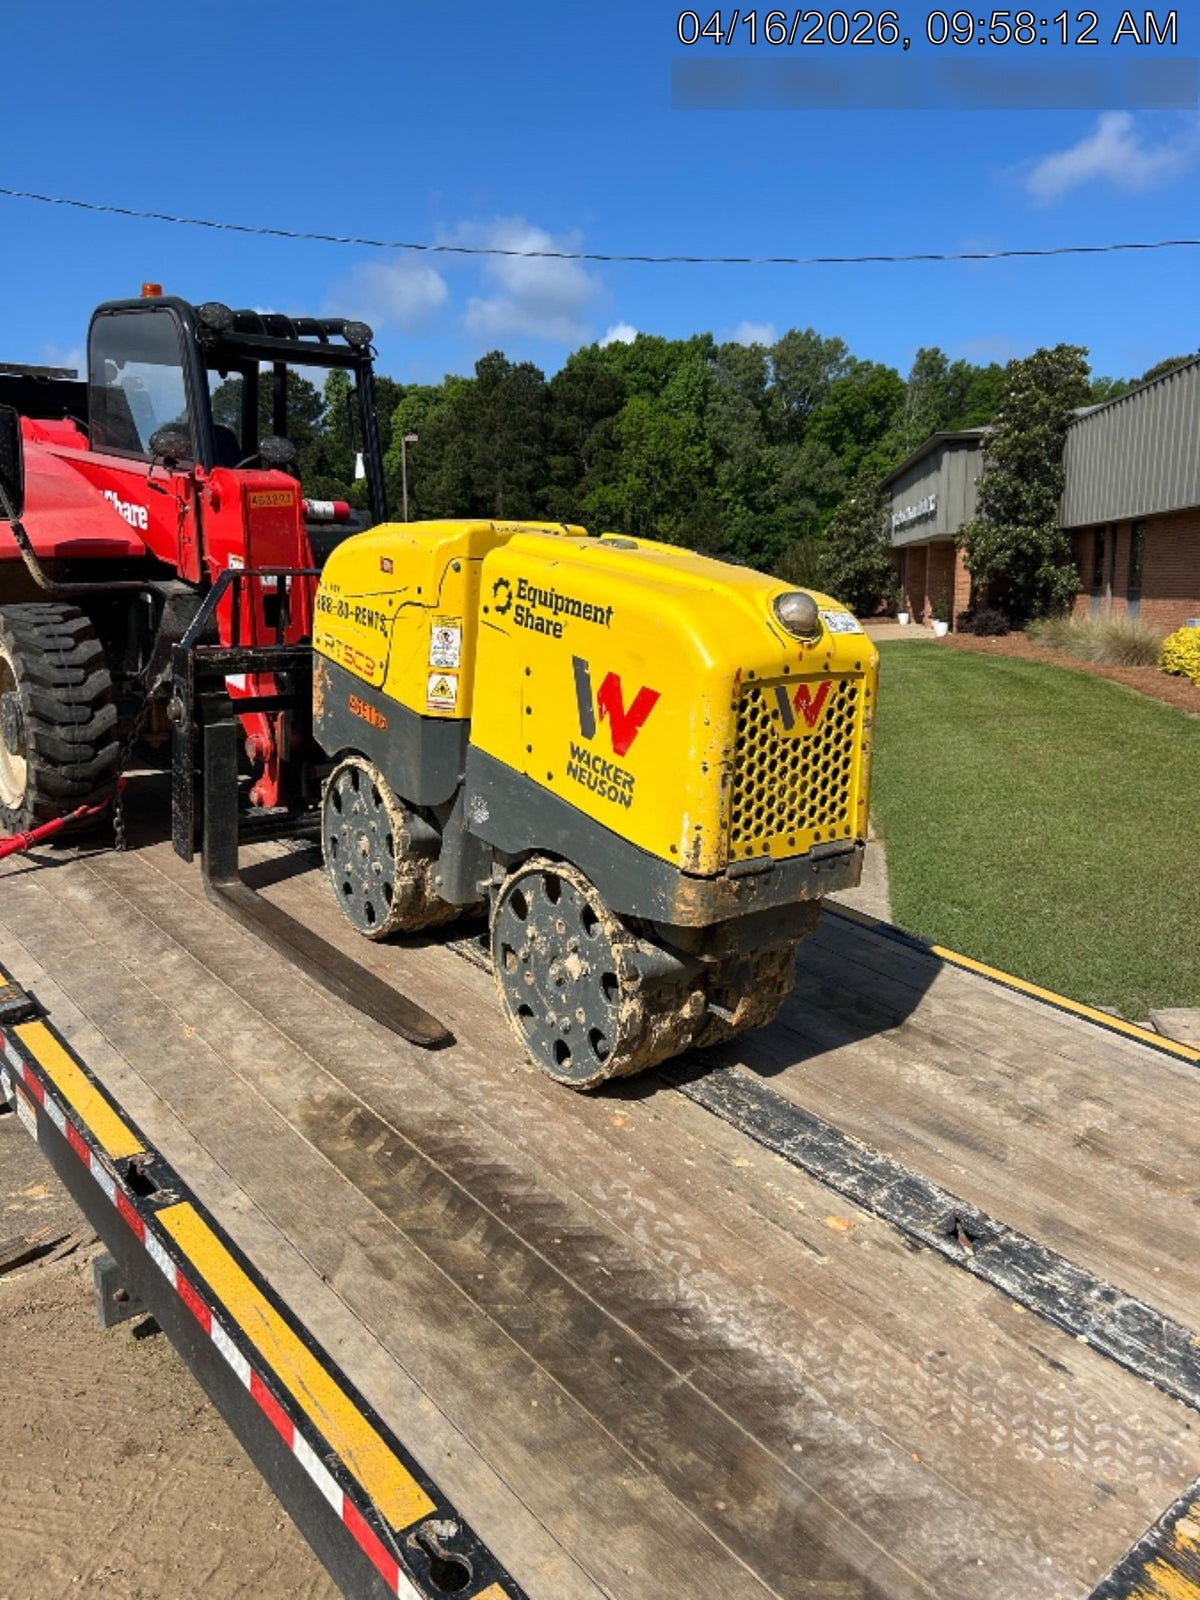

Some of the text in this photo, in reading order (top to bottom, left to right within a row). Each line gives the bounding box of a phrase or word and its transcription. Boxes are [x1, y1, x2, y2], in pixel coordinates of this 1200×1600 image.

[513, 603, 563, 639] Share
[516, 577, 614, 629] Equipment
[566, 760, 634, 810] NEUSON
[569, 741, 635, 793] WACKER
